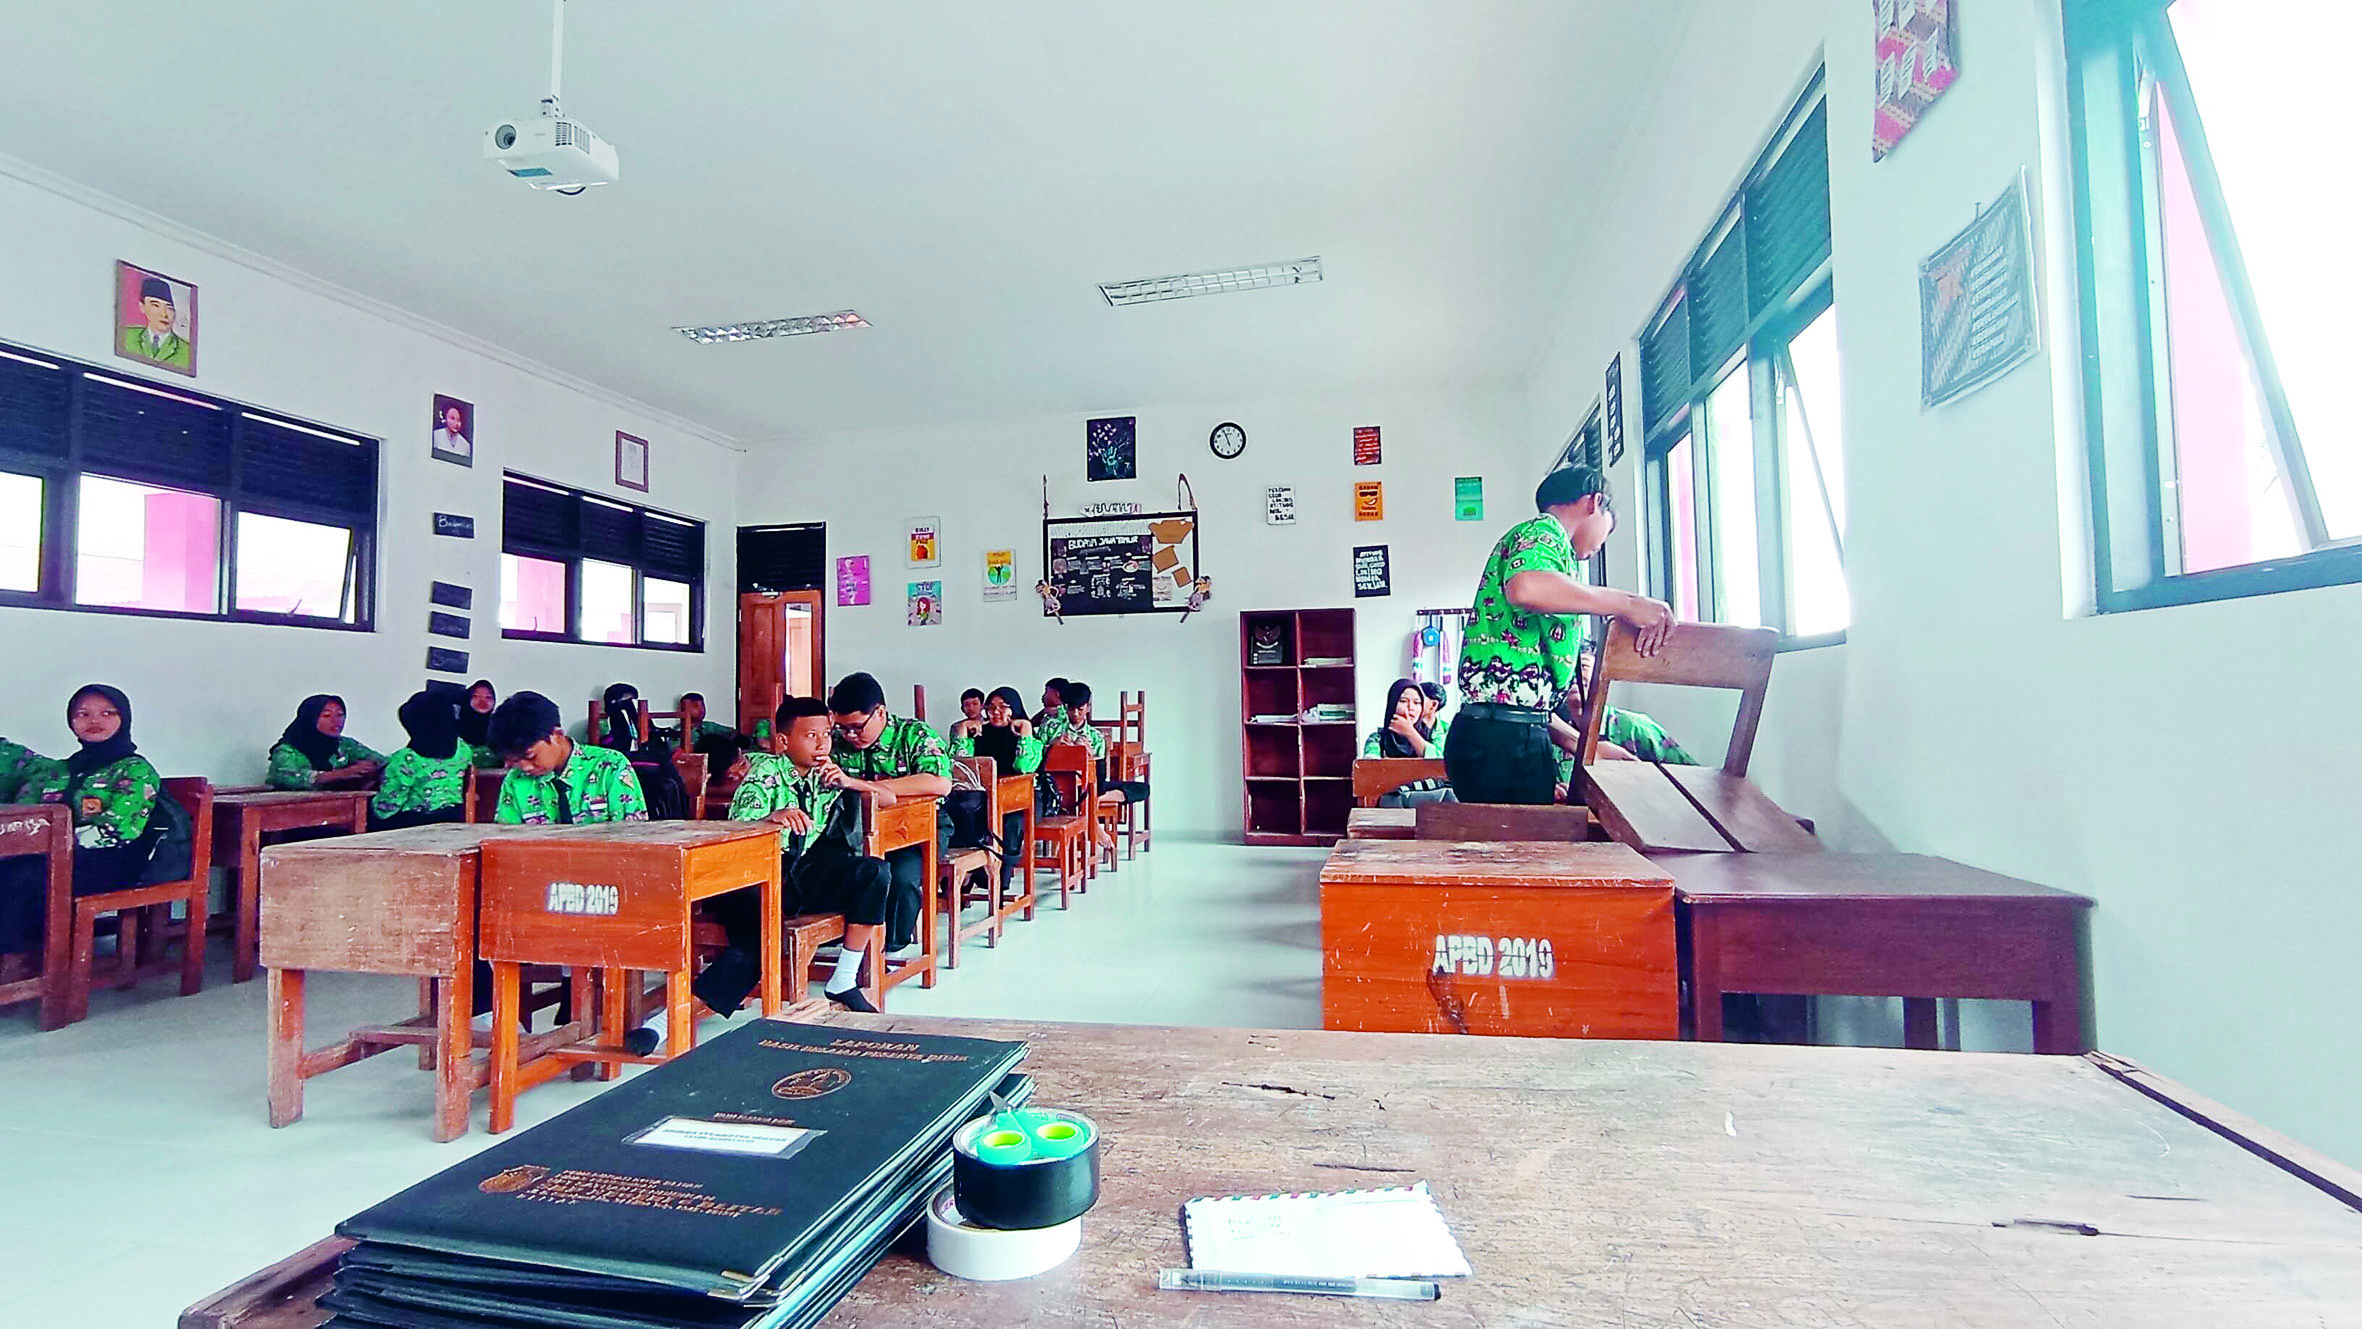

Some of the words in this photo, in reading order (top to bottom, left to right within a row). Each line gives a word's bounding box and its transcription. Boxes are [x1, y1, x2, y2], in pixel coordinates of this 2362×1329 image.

[547, 882, 585, 913] APBD
[585, 884, 619, 915] 2019
[1432, 934, 1494, 976] APBD
[1498, 936, 1556, 978] 2019
